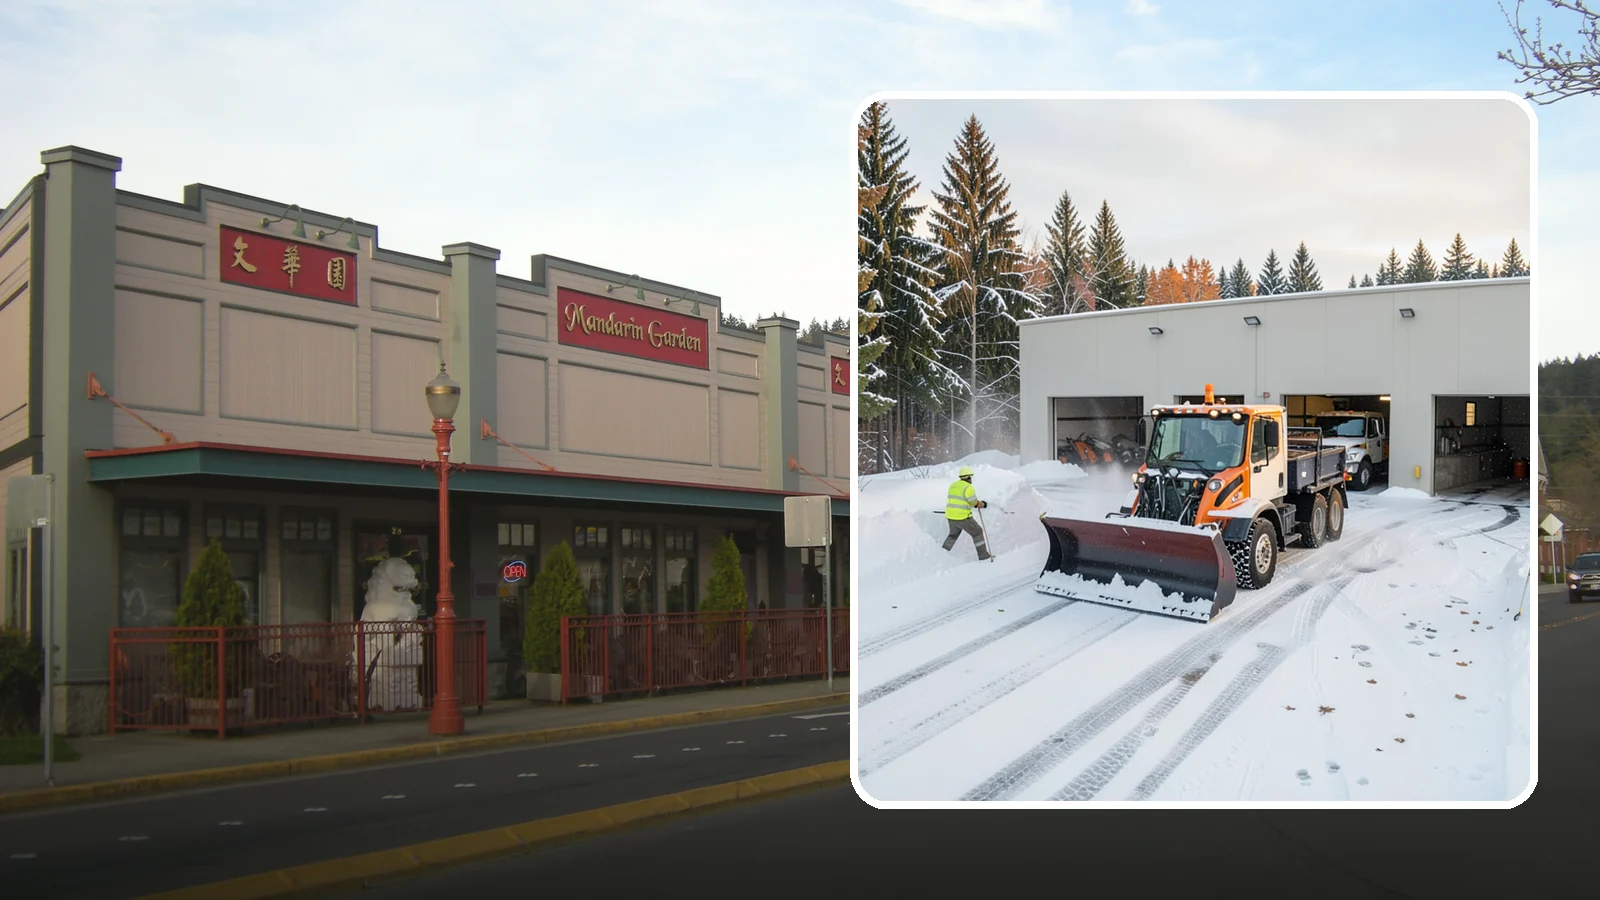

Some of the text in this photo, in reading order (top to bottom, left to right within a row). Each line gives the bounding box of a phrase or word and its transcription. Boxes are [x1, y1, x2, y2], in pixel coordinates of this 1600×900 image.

[231, 235, 346, 291] 文華園
[564, 302, 701, 352] Mandarin Garden
[503, 565, 527, 578] OPEN
